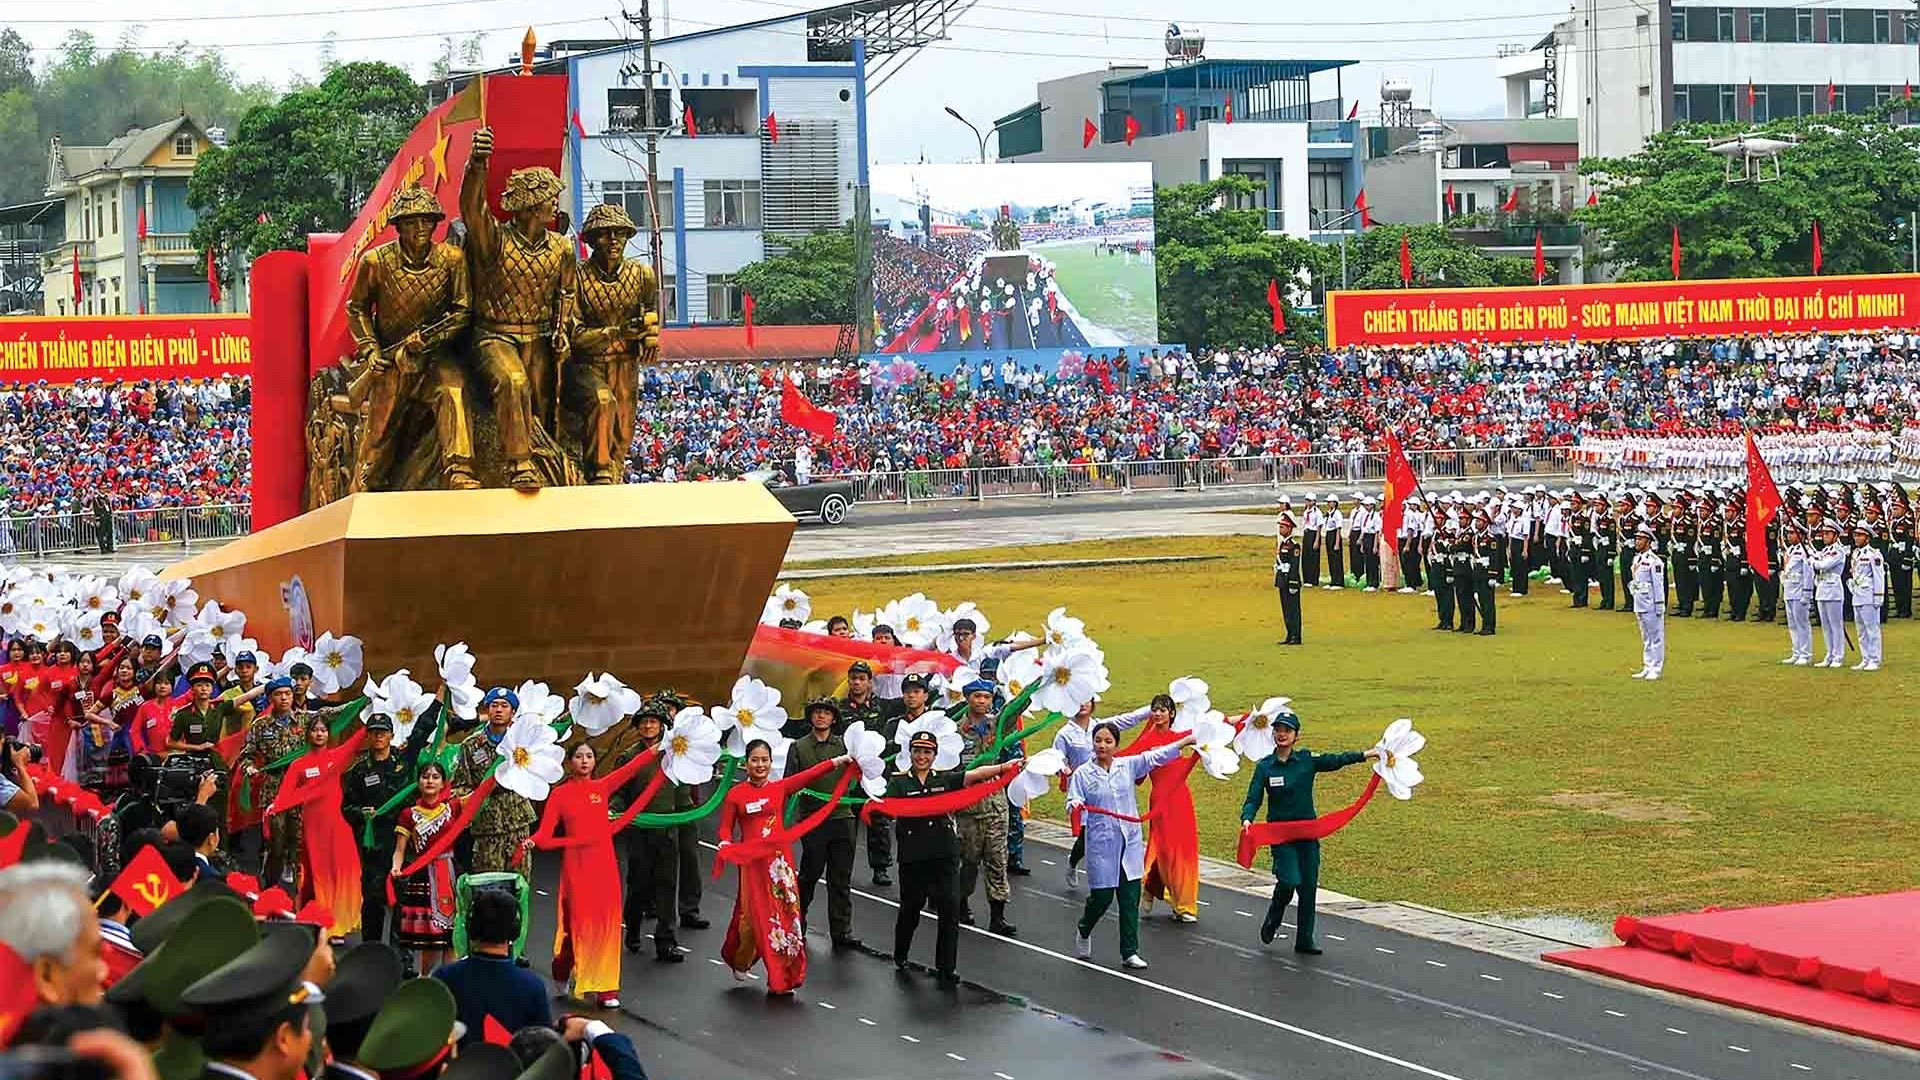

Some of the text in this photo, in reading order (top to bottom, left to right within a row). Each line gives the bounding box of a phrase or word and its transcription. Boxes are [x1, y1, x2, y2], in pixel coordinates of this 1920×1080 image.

[1363, 301, 1406, 333] CHIẾN
[1410, 299, 1458, 332] THẮNG
[1461, 302, 1496, 336] ĐIỆN
[1501, 301, 1534, 331] BIÊN
[1538, 297, 1568, 329] PHỦ
[1581, 299, 1611, 328] SỨC
[1615, 301, 1660, 331] MẠNH
[1663, 295, 1694, 329] VIỆT
[1700, 301, 1733, 323] NAM
[1736, 292, 1771, 321] THỜI
[1774, 296, 1800, 326] ĐẠI
[1827, 289, 1854, 318] CHÍ
[42, 329, 89, 370] THẮNG
[91, 333, 127, 373] ĐIỆN
[130, 332, 165, 368] BIÊN
[169, 327, 198, 365] PHỦ
[211, 330, 251, 364] LỪNG
